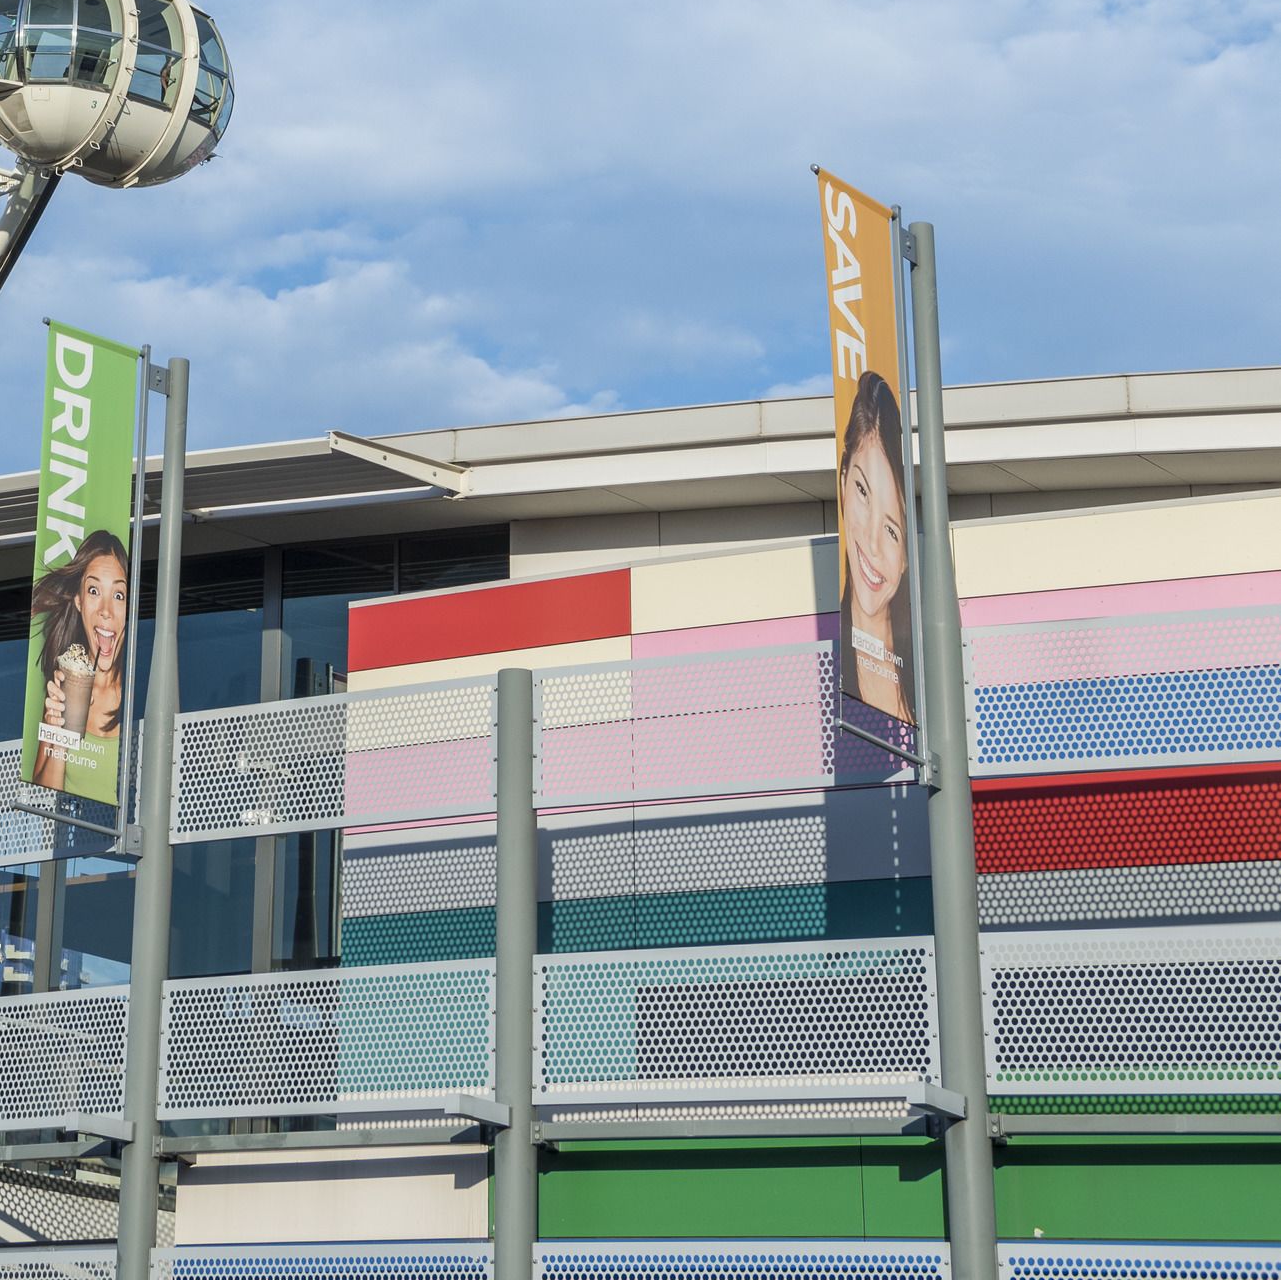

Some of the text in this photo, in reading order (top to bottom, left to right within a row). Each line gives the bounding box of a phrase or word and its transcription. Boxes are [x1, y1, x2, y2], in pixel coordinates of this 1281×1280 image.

[91, 100, 98, 109] 3
[825, 181, 867, 381] SAVE
[44, 332, 94, 565] DRINK
[884, 648, 903, 668] town
[80, 737, 105, 755] town
[44, 746, 97, 769] melbourne
